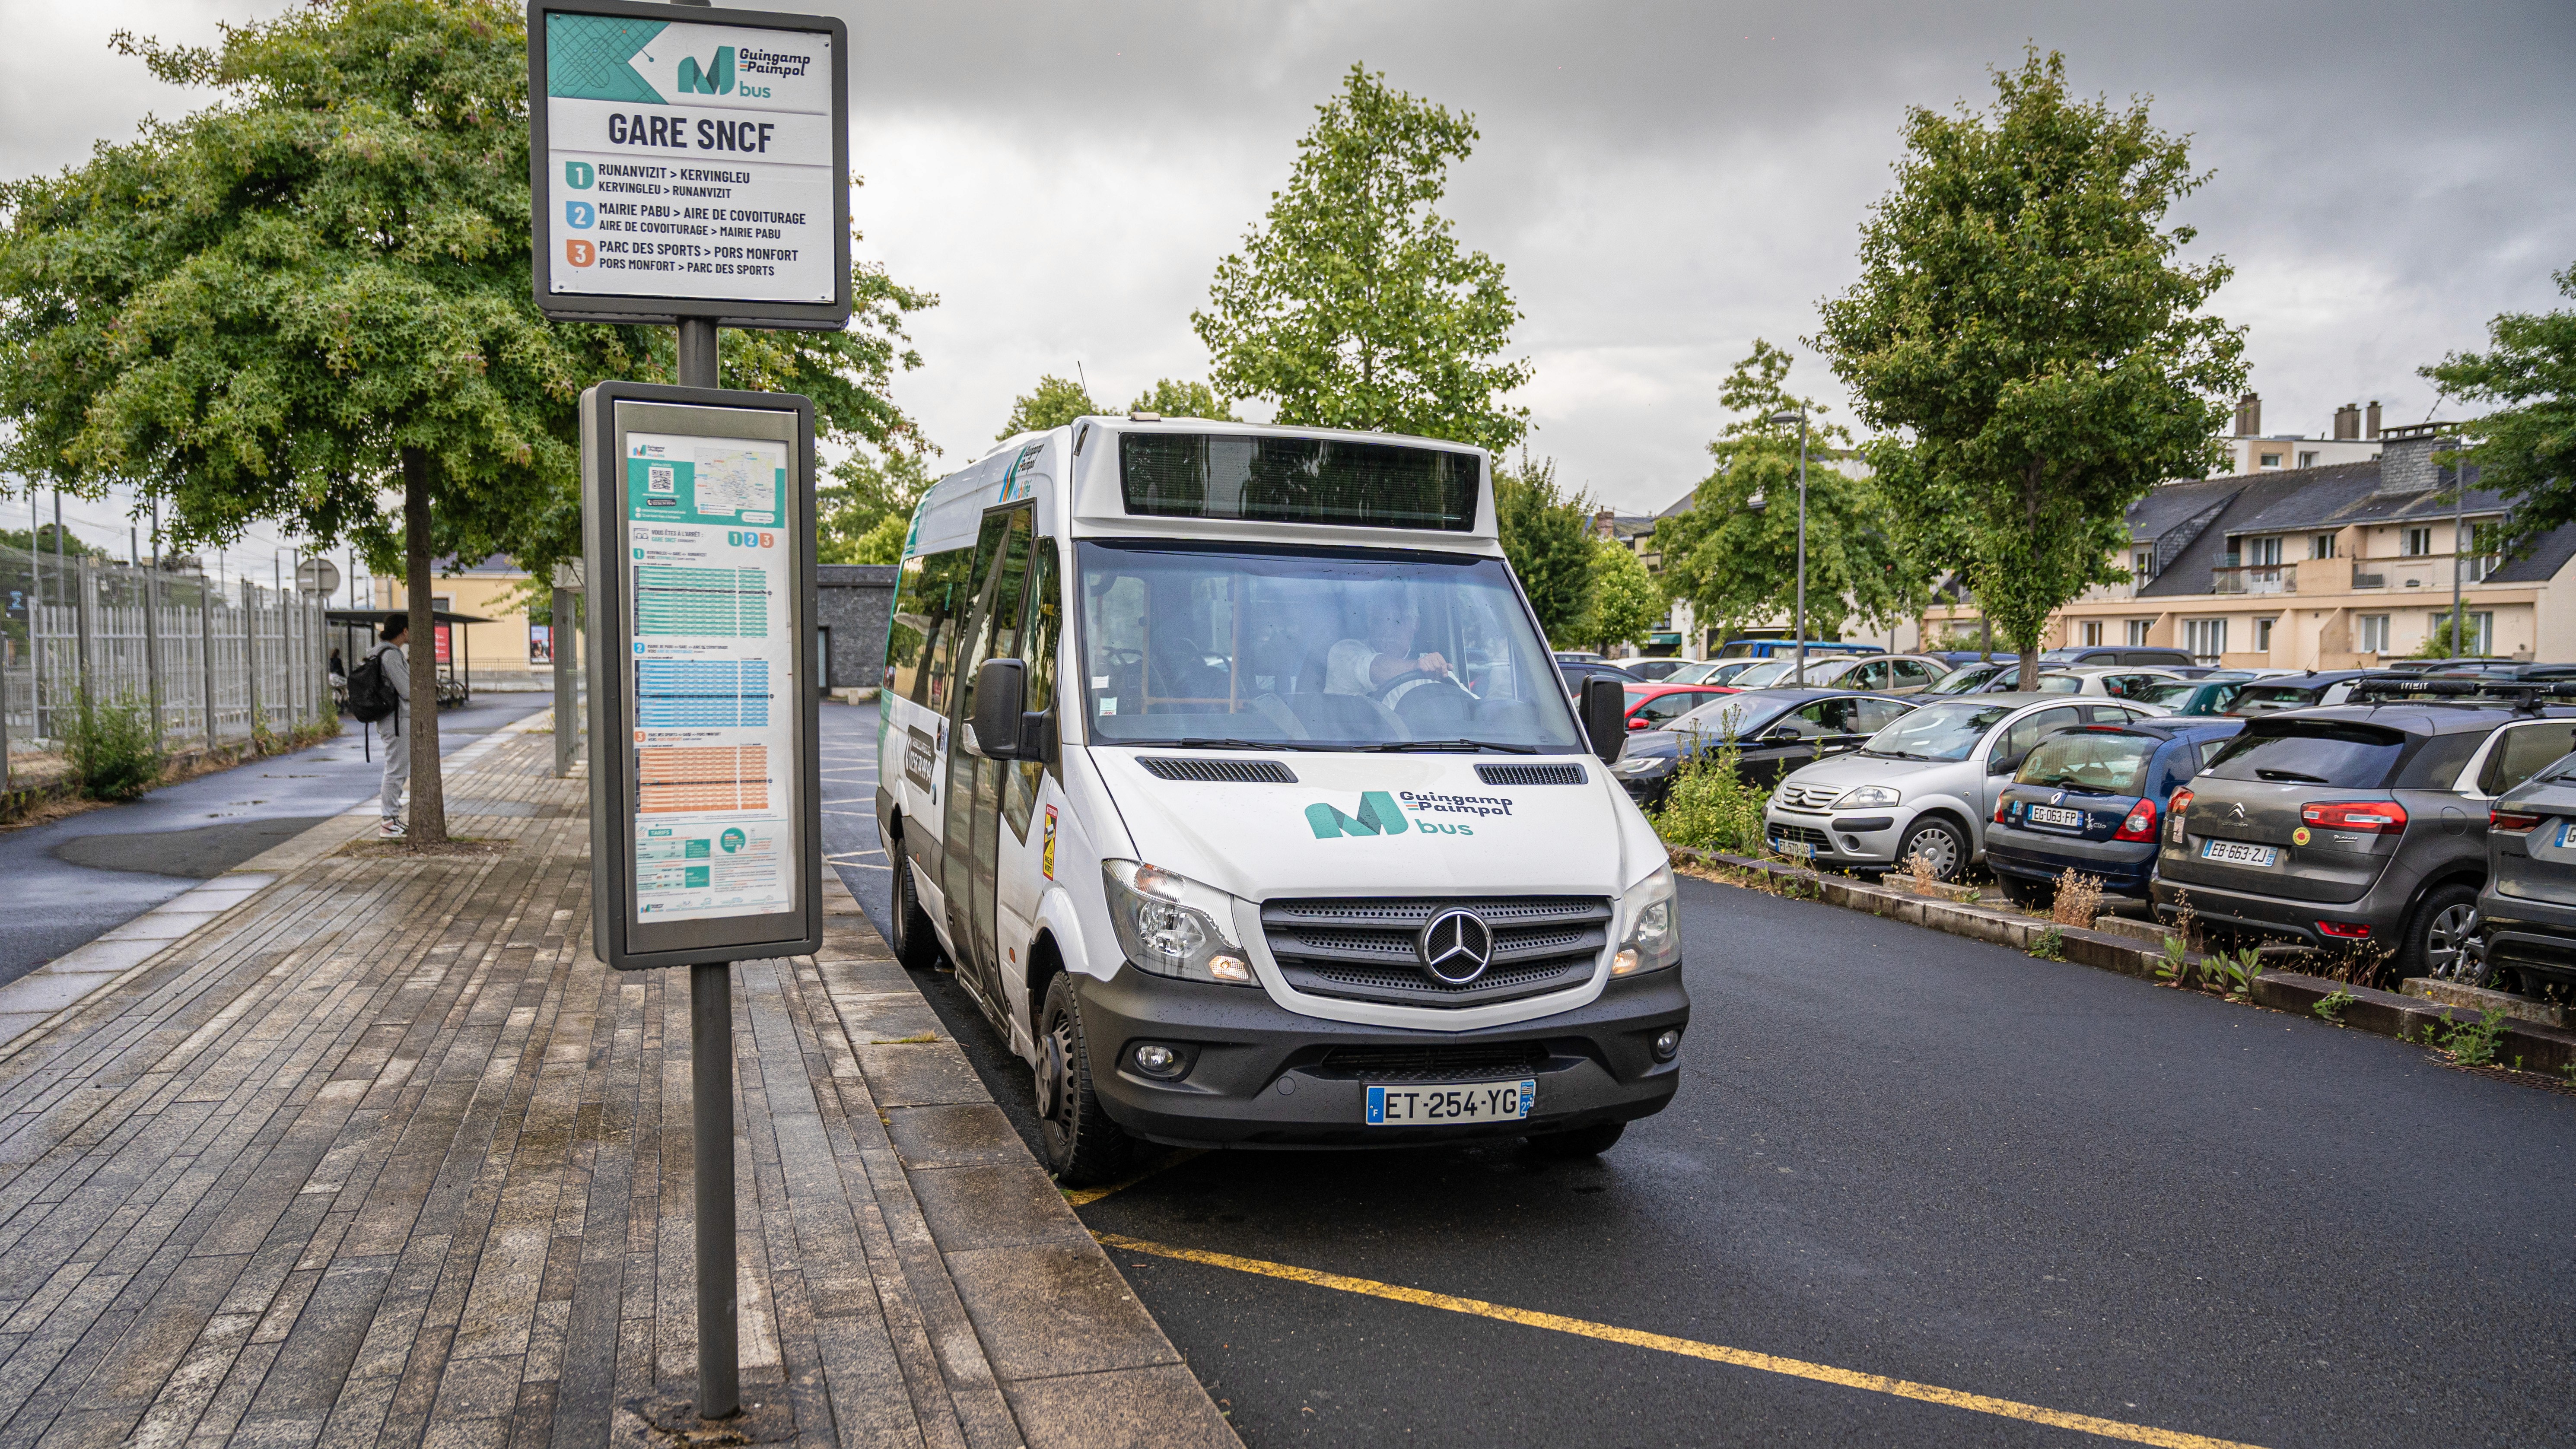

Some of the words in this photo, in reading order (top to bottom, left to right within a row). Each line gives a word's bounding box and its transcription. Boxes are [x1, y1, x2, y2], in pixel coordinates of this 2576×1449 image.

[740, 48, 811, 65] Guingamp
[747, 61, 805, 79] Paimpol
[740, 81, 771, 99] bus
[609, 113, 687, 148] GARE
[697, 119, 774, 153] SNCF
[576, 167, 583, 185] 1
[599, 164, 667, 178] RUNANVIZIT
[681, 169, 750, 184] KERVINGLEU
[599, 182, 661, 194] KERVINGLEU
[673, 186, 731, 198] RUNANVIZIT
[575, 207, 586, 225] 2
[600, 203, 637, 215] MAIRIE
[642, 205, 670, 217] PABU
[684, 208, 709, 219] AIRE
[713, 209, 726, 220] DE
[731, 210, 806, 225] COVOITURAGE
[600, 220, 621, 231] AIRE
[626, 222, 637, 232] DE
[641, 222, 708, 235] COVOITURAGE
[721, 227, 752, 238] MAIRIE
[756, 229, 780, 239] PABU
[575, 245, 586, 263] 3
[600, 241, 629, 253] PARC
[633, 242, 654, 254] DES
[658, 244, 701, 257] SPORTS
[715, 247, 743, 259] PORS
[747, 248, 798, 261] MONFORT
[600, 258, 626, 269] PORS
[629, 260, 675, 271] MONFORT
[688, 263, 712, 273] PARC
[716, 264, 734, 274] DES
[737, 265, 774, 276] SPORTS
[733, 534, 738, 544] 1
[748, 534, 754, 545] 2
[763, 535, 770, 546] 3
[637, 550, 641, 558] 1
[2401, 682, 2429, 690] ITIWIT
[638, 733, 643, 741] 3
[1399, 791, 1513, 806] Guingamp
[1418, 801, 1513, 817] Paimpol
[2034, 807, 2076, 824] EG-063-FP
[1414, 819, 1474, 836] bus
[2211, 843, 2268, 862] EB-663-ZJ
[1385, 1088, 1517, 1119] ET-254-YG
